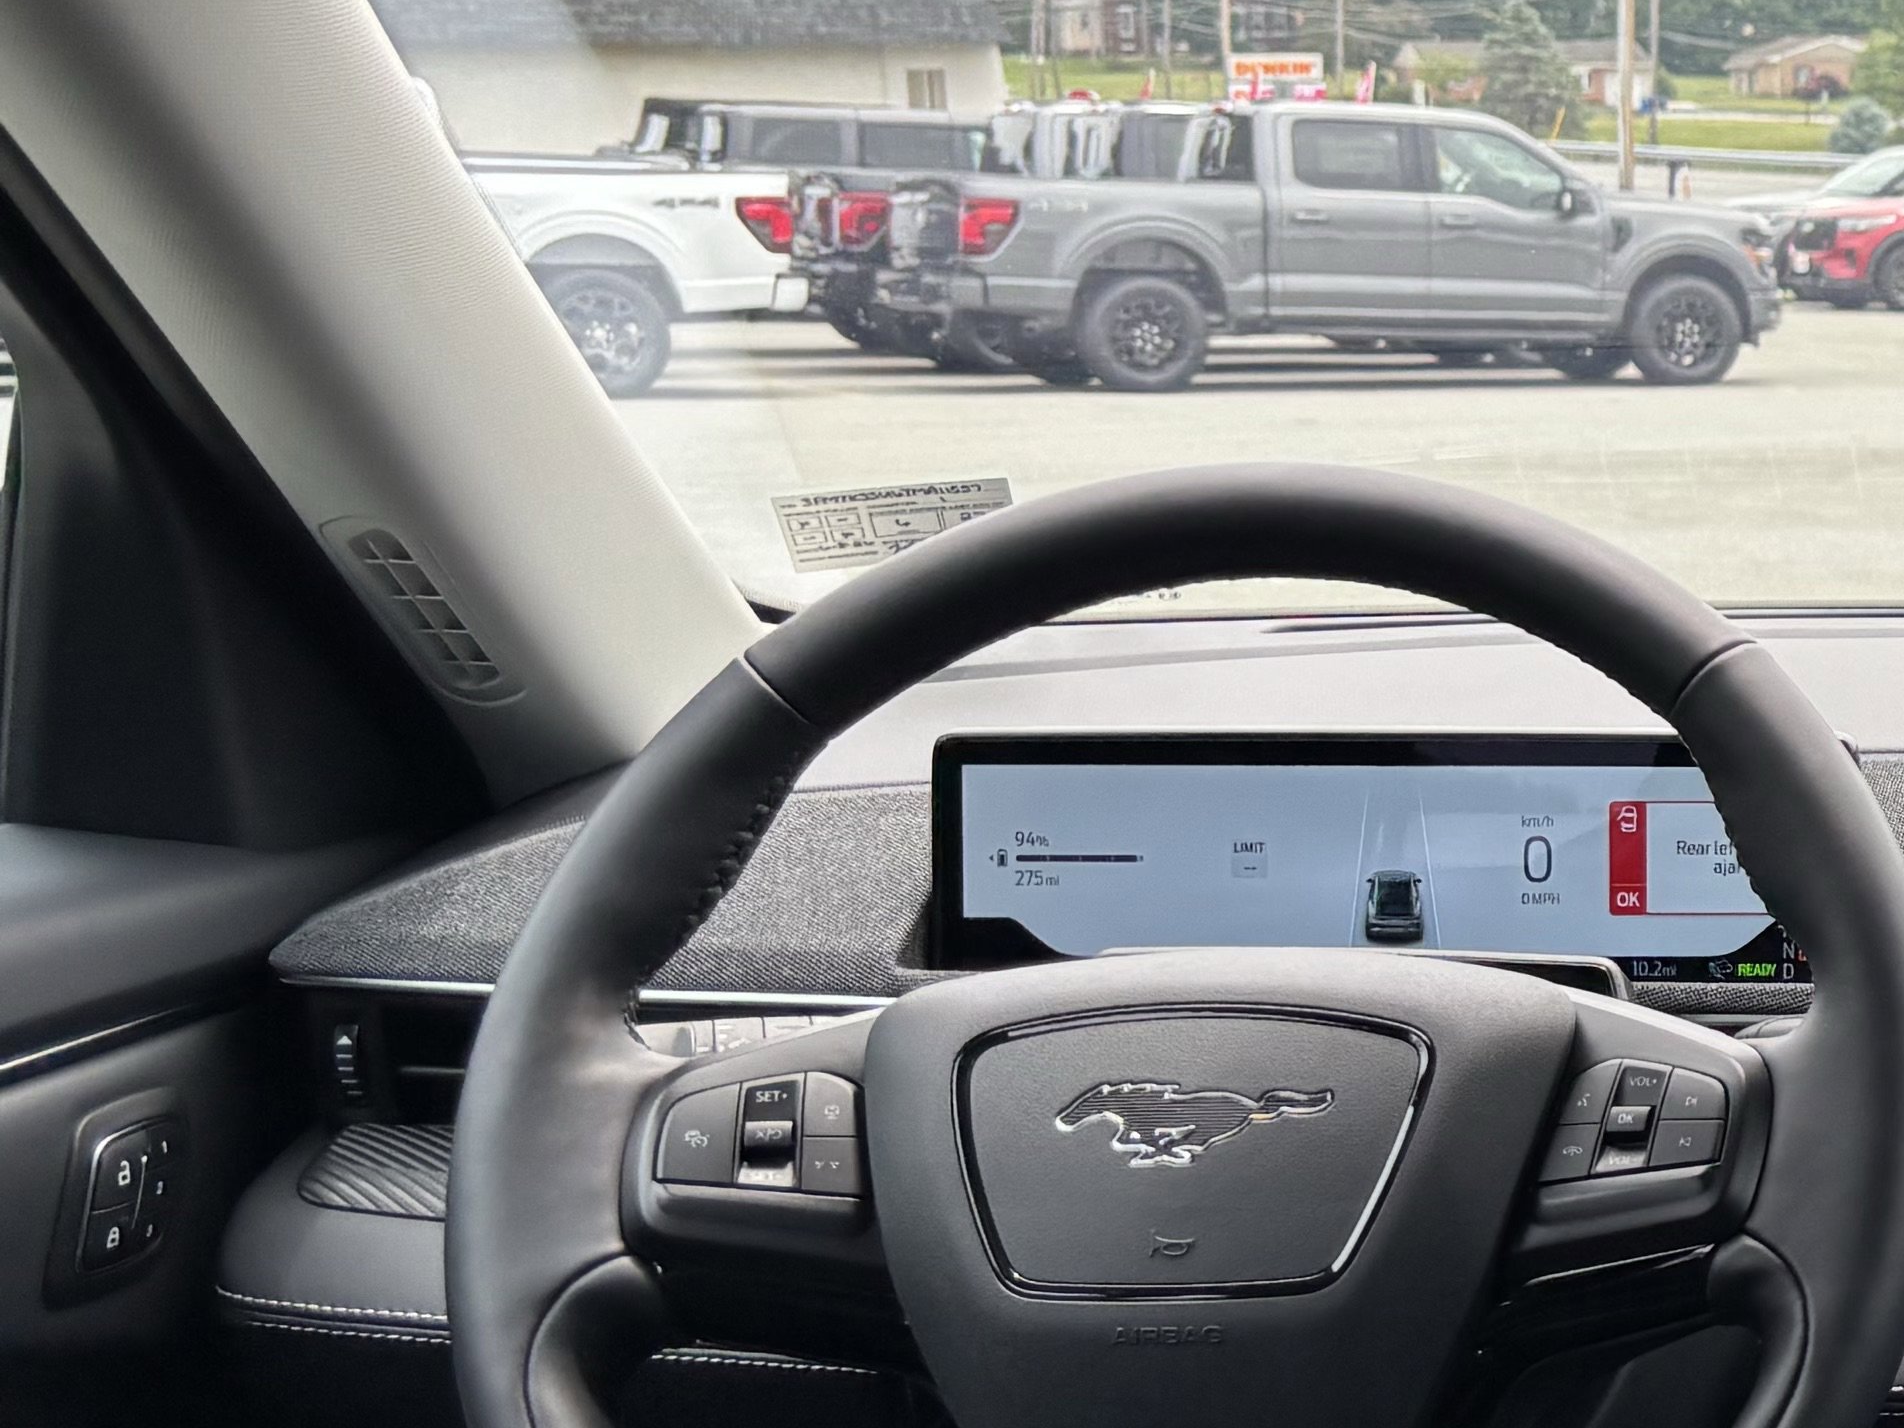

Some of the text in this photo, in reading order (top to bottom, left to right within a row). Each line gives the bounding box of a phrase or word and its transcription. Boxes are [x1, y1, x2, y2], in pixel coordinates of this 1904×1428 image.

[1233, 841, 1266, 855] LIMIT
[1523, 835, 1553, 884] 0
[1677, 841, 1709, 855] Rear
[1015, 871, 1044, 887] 275
[1616, 892, 1641, 908] OK
[1784, 942, 1794, 959] N
[1632, 961, 1658, 978] 10.2
[1738, 963, 1776, 977] READY
[1783, 963, 1794, 979] D
[1618, 1113, 1633, 1124] OK
[1111, 1324, 1225, 1346] AIRBAG
